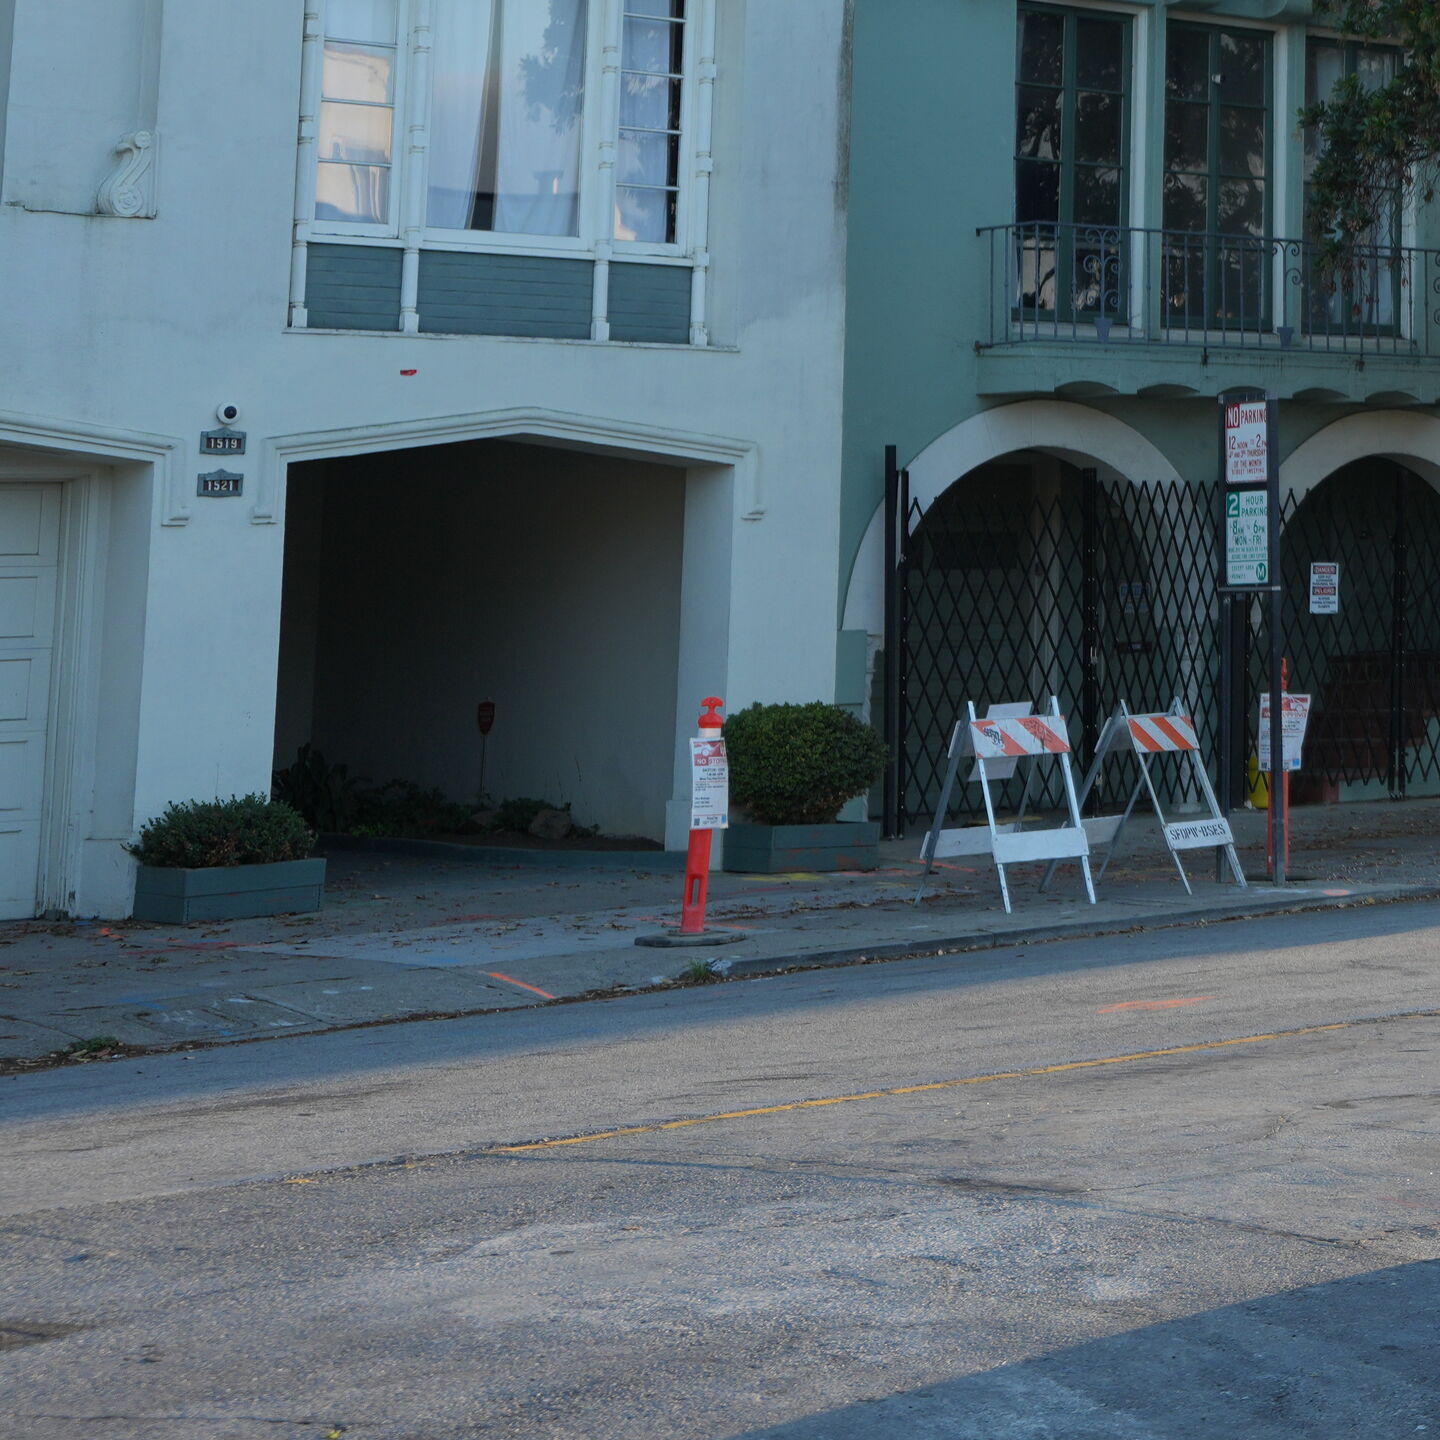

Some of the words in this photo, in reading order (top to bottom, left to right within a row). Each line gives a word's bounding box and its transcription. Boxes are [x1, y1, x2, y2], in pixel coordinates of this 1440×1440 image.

[1227, 407, 1239, 427] NO
[210, 438, 238, 449] 1519
[1228, 435, 1236, 450] 12
[207, 480, 233, 491] 1521
[1228, 494, 1239, 516] 2
[1245, 495, 1264, 506] HOUR
